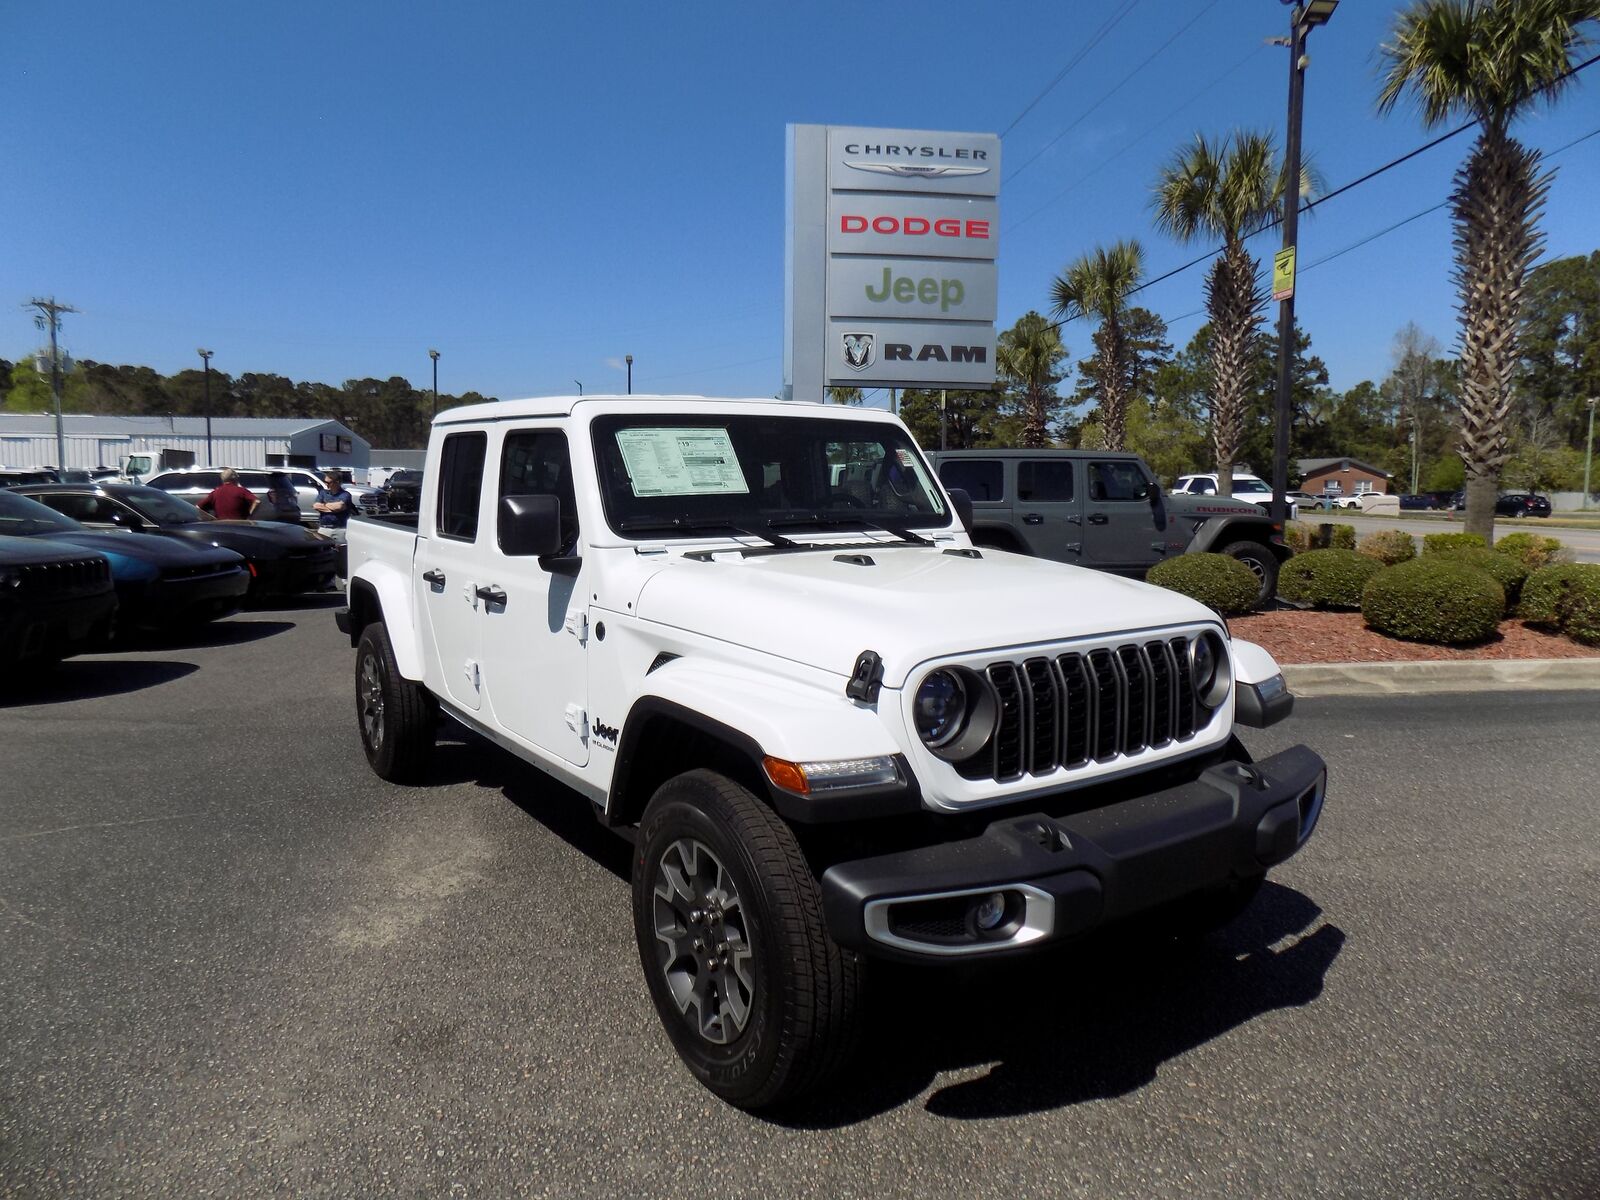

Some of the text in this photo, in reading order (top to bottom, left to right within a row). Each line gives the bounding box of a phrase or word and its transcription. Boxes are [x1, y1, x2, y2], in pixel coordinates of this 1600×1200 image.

[845, 144, 987, 160] CHRYSLER
[841, 215, 990, 239] DODGE
[865, 267, 965, 312] Jeep
[884, 344, 987, 363] RAM
[1196, 506, 1257, 514] RUBICON
[592, 717, 618, 745] Jeep
